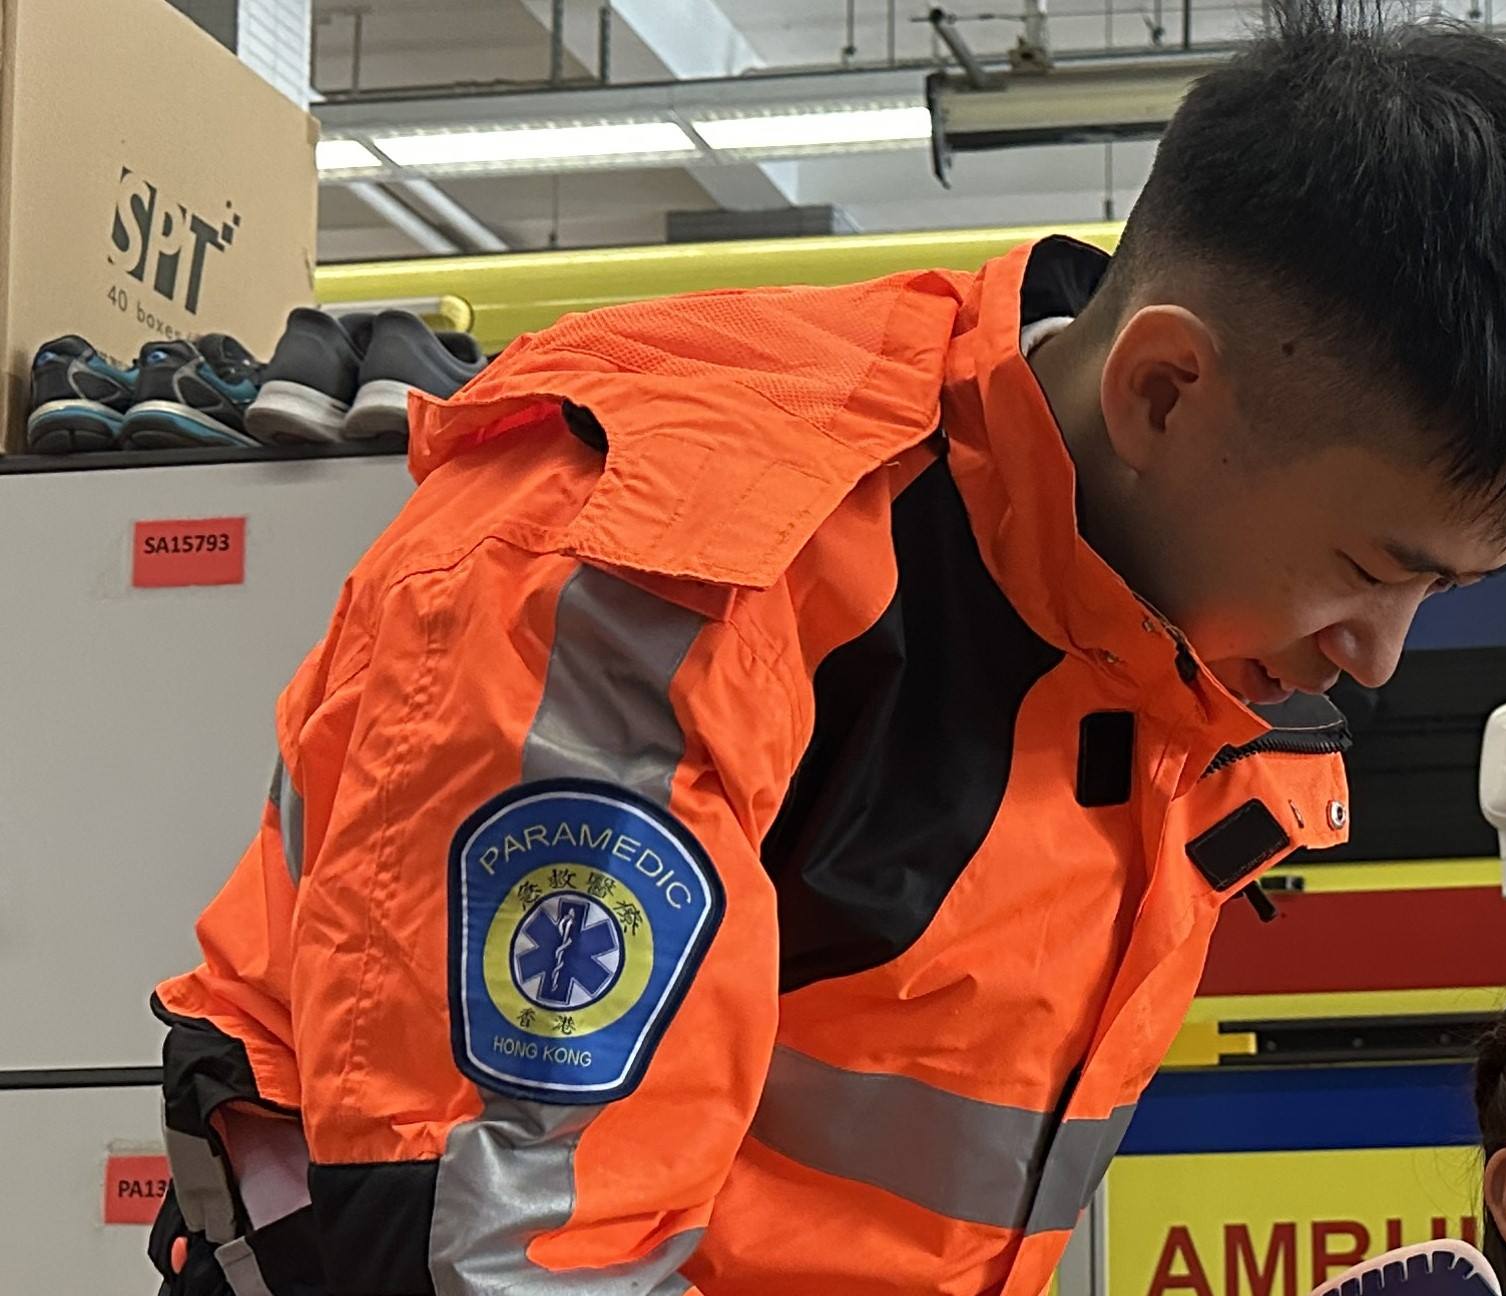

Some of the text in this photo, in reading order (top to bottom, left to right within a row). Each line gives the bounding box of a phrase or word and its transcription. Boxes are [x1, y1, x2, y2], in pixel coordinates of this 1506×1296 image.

[108, 165, 227, 316] SPT
[107, 285, 128, 312] 40
[144, 534, 230, 556] SA15793
[478, 821, 692, 910] PARAMEDIC
[517, 1007, 577, 1036] 香港
[493, 1035, 592, 1068] HONG KONG
